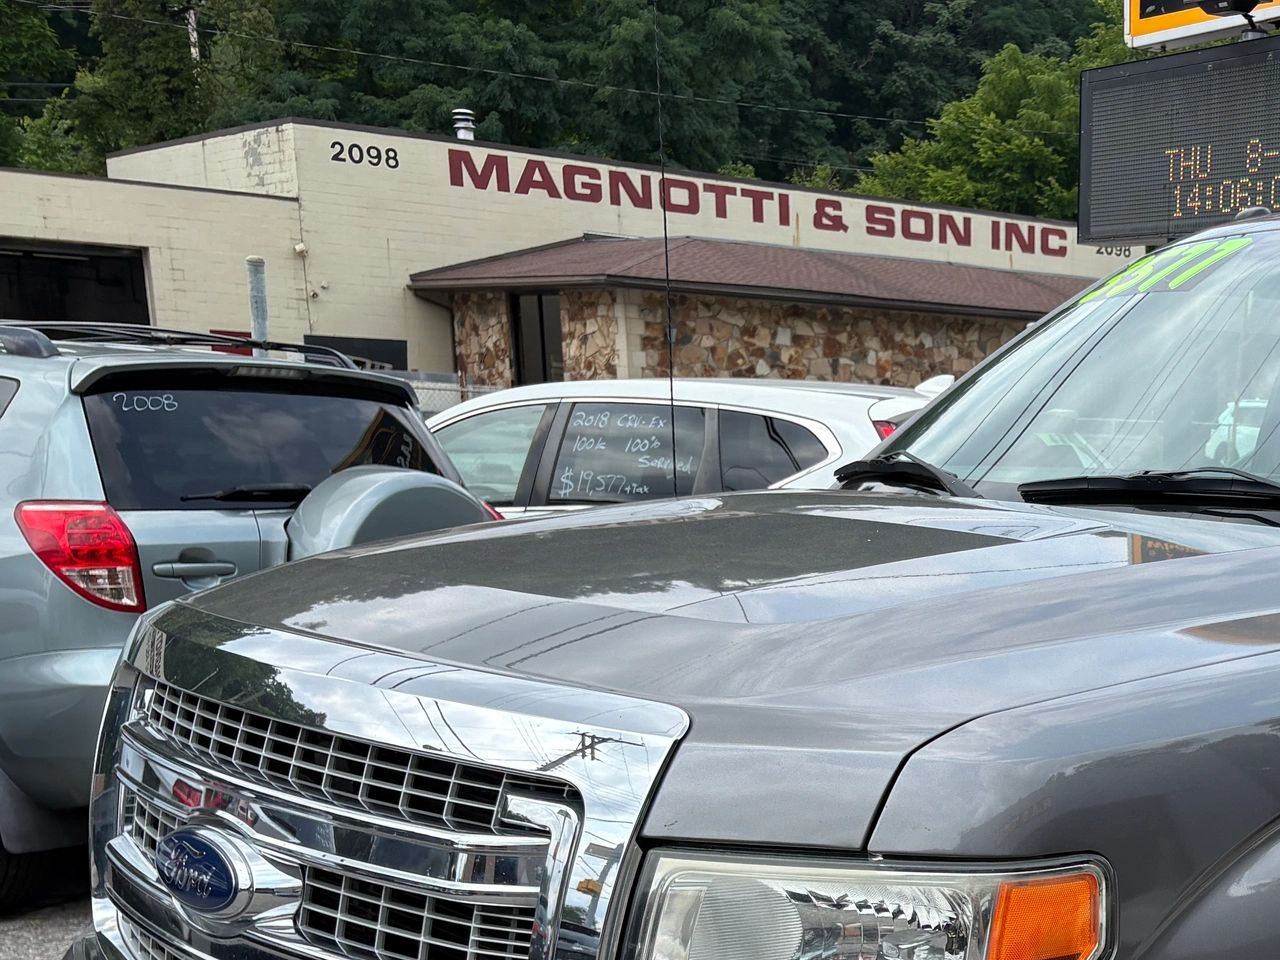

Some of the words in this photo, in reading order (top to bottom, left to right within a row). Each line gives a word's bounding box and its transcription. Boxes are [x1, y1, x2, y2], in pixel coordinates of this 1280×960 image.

[330, 140, 400, 169] 2098
[1165, 144, 1211, 181] THU
[447, 148, 790, 227] MAGNOTTI
[813, 198, 849, 233] &
[865, 204, 972, 247] SON
[991, 220, 1068, 258] INC
[112, 392, 178, 411] 2008
[573, 411, 610, 428] 2018
[164, 836, 215, 899] Ford
